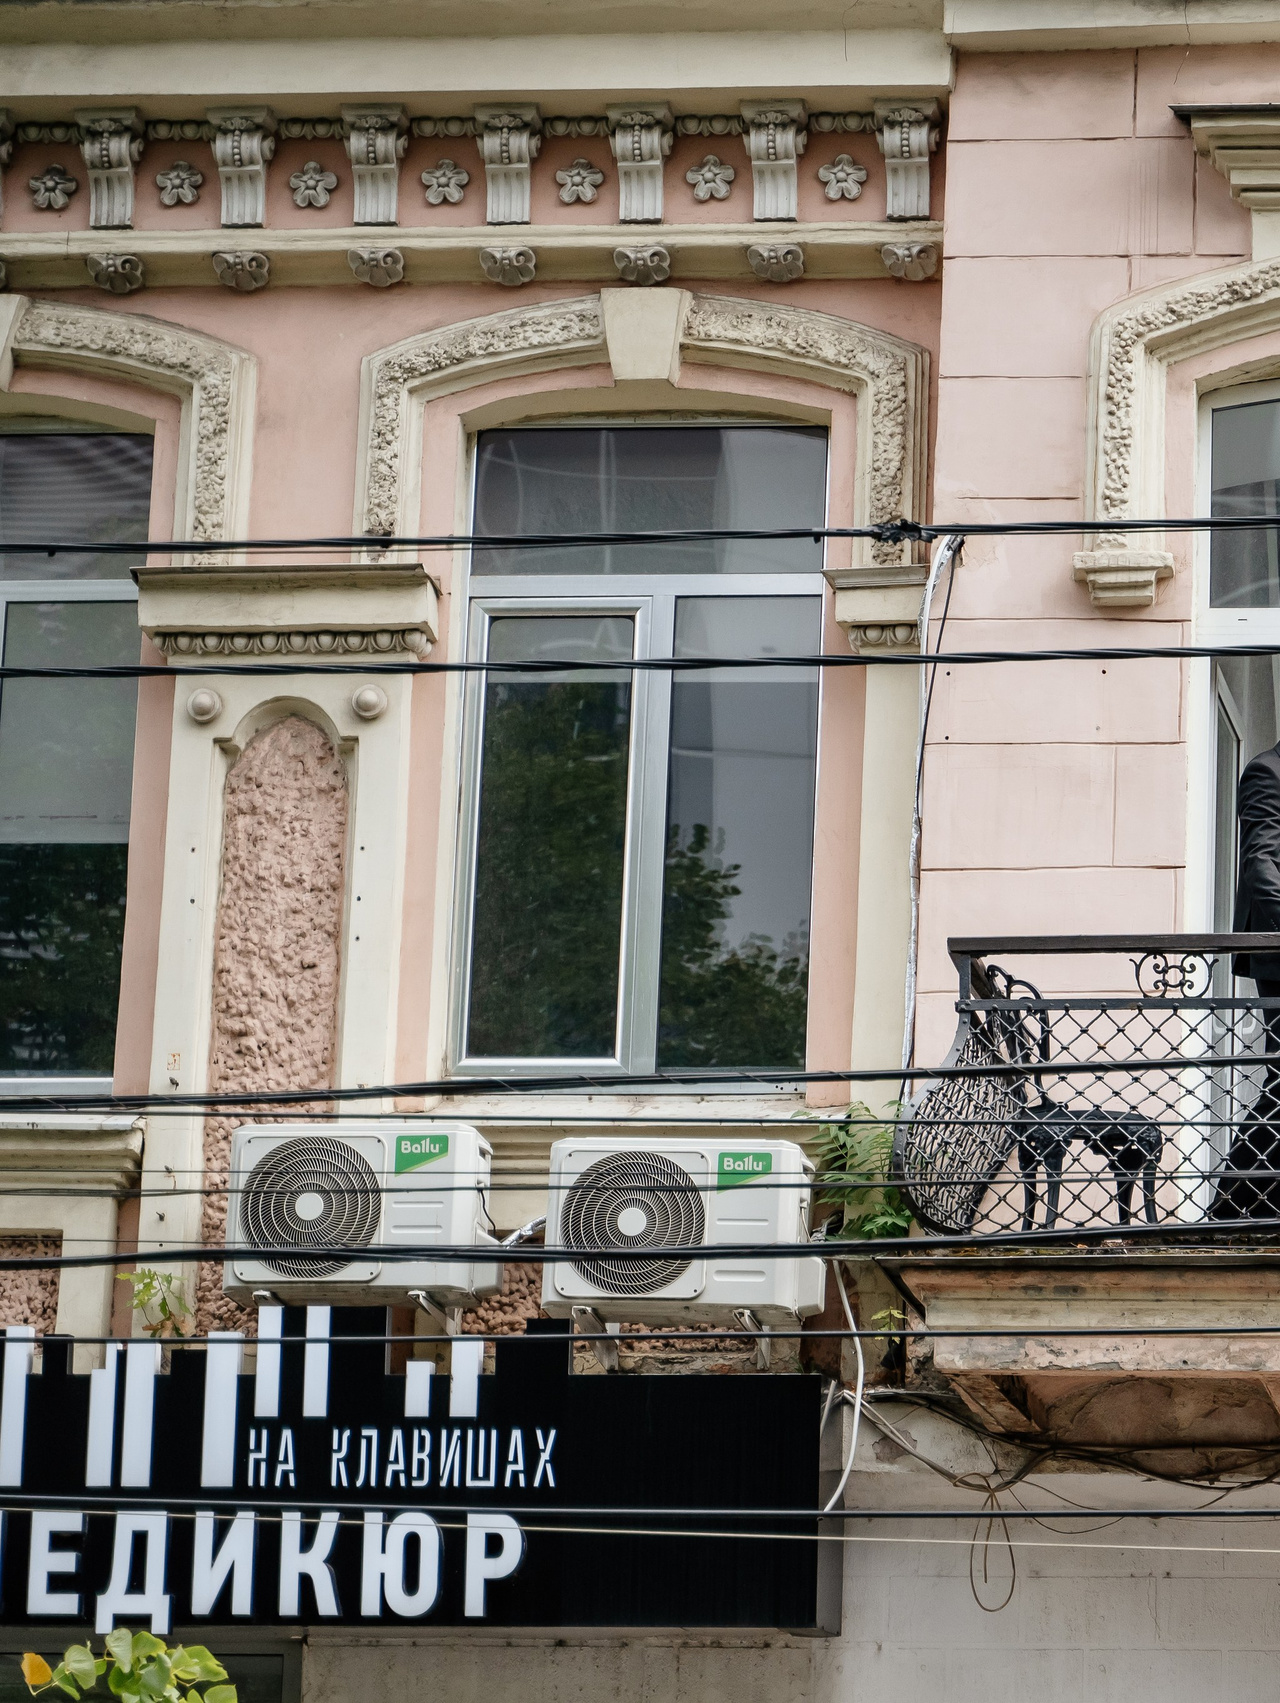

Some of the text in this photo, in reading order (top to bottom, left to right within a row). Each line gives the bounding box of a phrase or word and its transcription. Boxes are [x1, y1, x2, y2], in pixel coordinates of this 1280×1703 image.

[401, 1138, 439, 1153] Ballu
[724, 1155, 762, 1171] Ballu
[248, 1429, 557, 1487] НА КЛАВИШАХ
[0, 1510, 526, 1634] ЕДИКЮР
